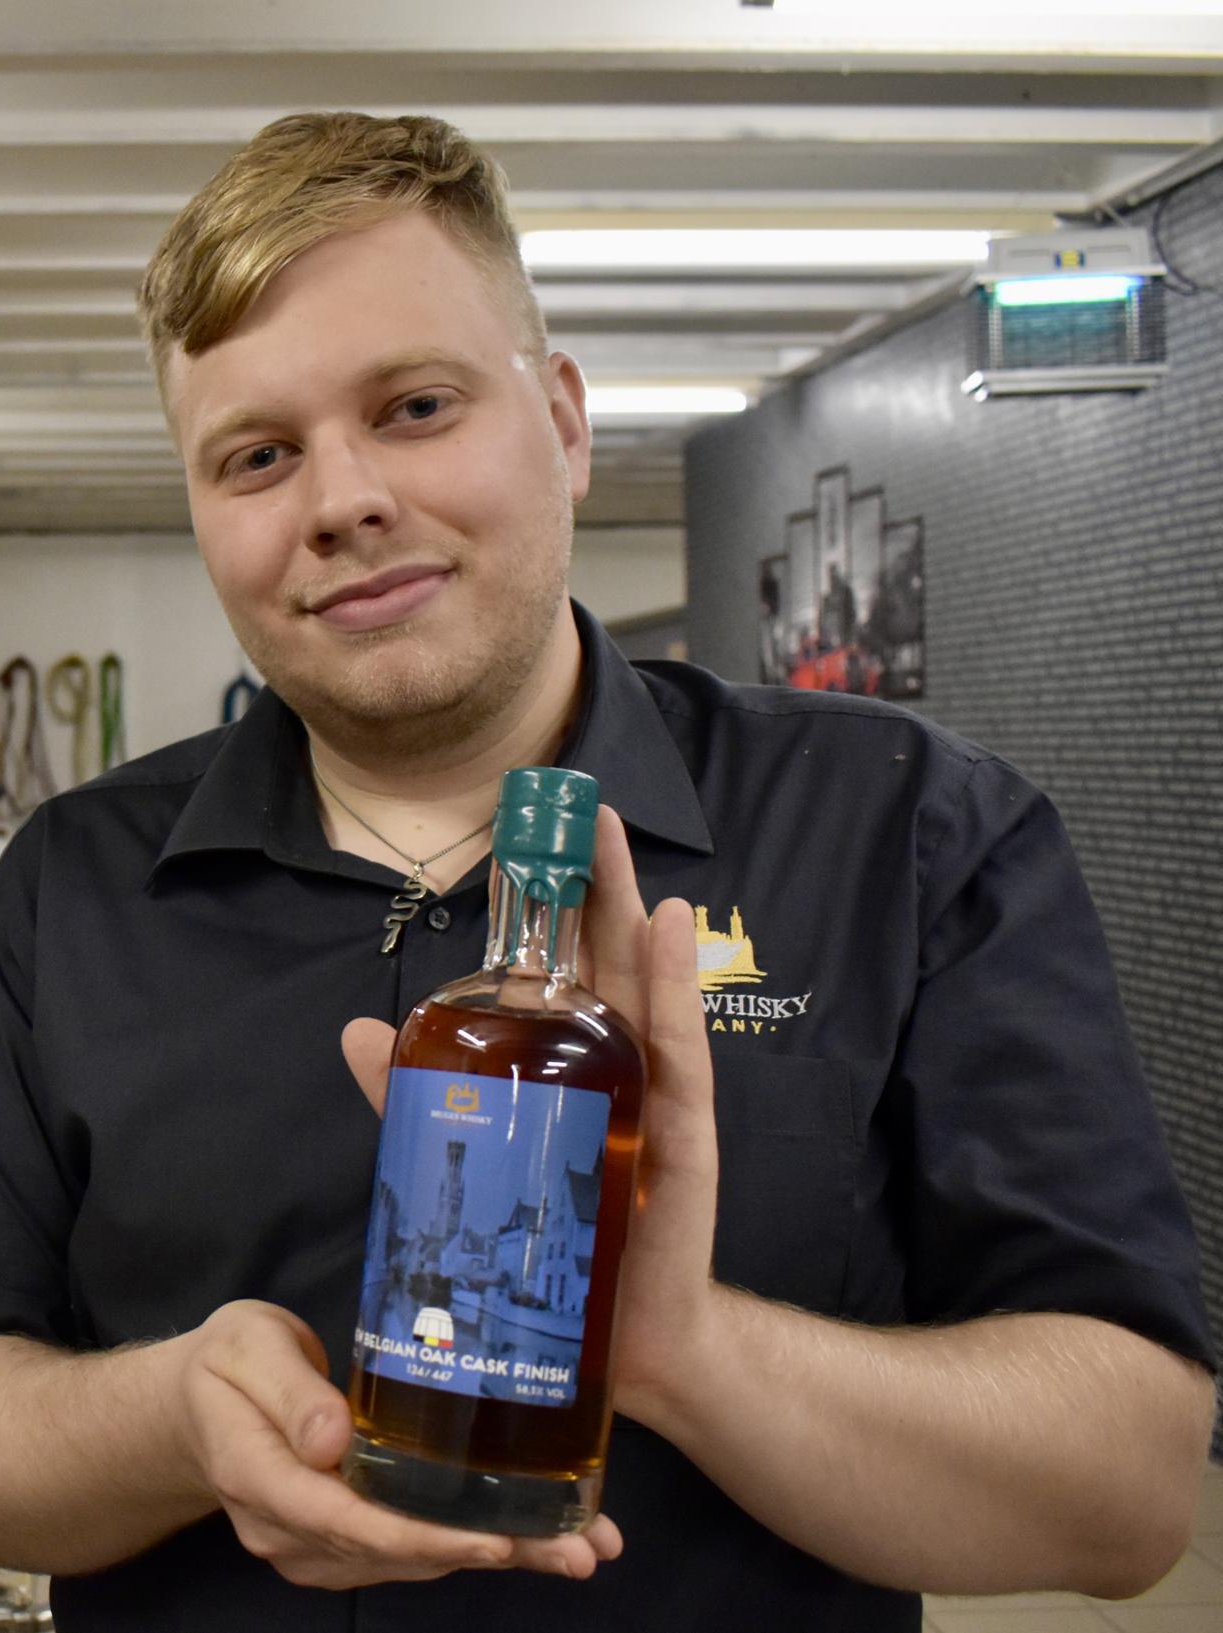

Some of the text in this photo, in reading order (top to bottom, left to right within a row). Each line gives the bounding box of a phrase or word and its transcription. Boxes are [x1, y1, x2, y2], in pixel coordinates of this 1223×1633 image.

[701, 991, 813, 1019] WHISKY
[363, 1331, 417, 1359] BELGIAN
[419, 1346, 457, 1367] OAK
[460, 1355, 509, 1377] CASK
[513, 1363, 570, 1384] FINISH
